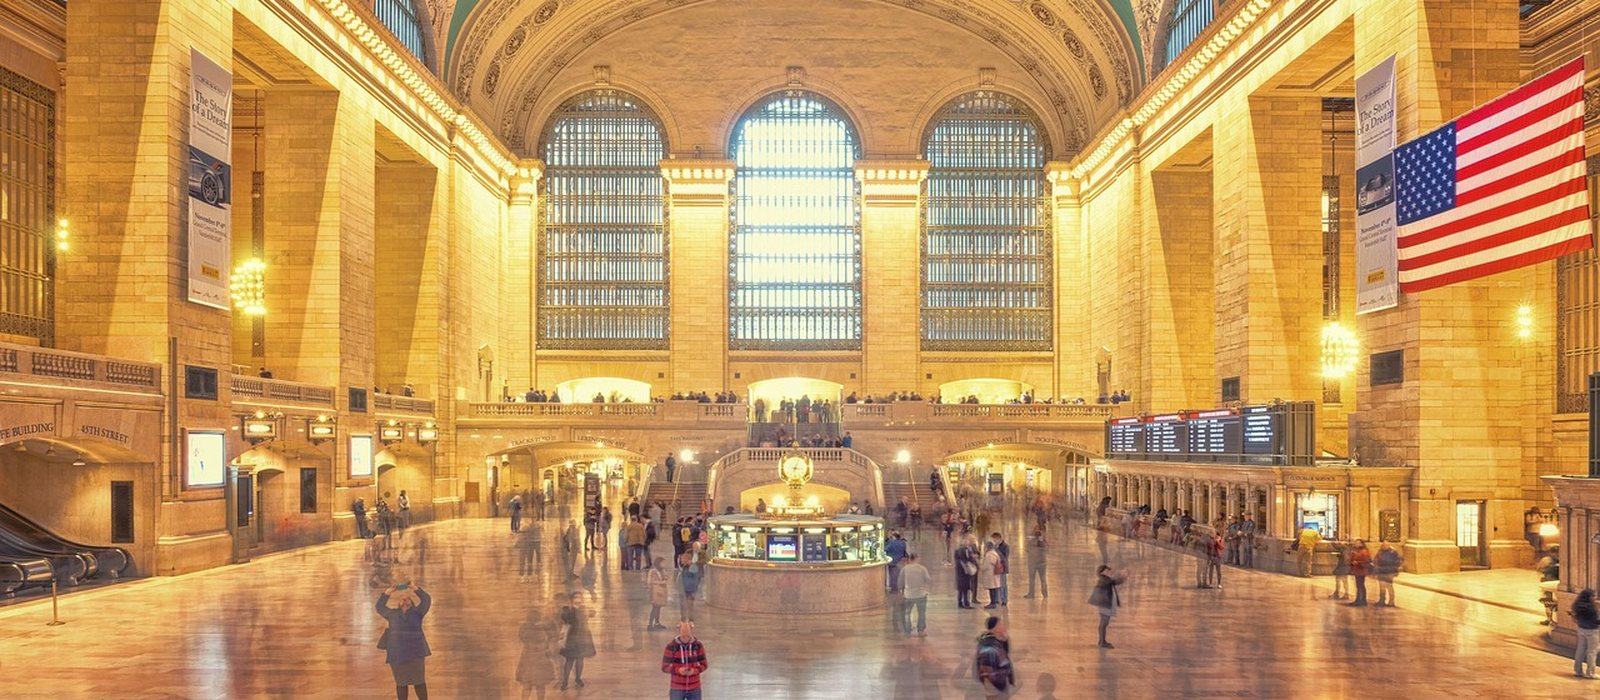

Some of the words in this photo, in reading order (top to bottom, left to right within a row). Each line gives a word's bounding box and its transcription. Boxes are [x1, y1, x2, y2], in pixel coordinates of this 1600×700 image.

[192, 103, 200, 114] of
[195, 88, 209, 108] The
[209, 99, 226, 121] Story
[1360, 110, 1371, 122] The
[1373, 99, 1391, 115] Story
[1370, 109, 1394, 129] Dream
[12, 422, 55, 438] BUILDING
[80, 424, 100, 436] 45TH
[101, 427, 129, 444] STREET
